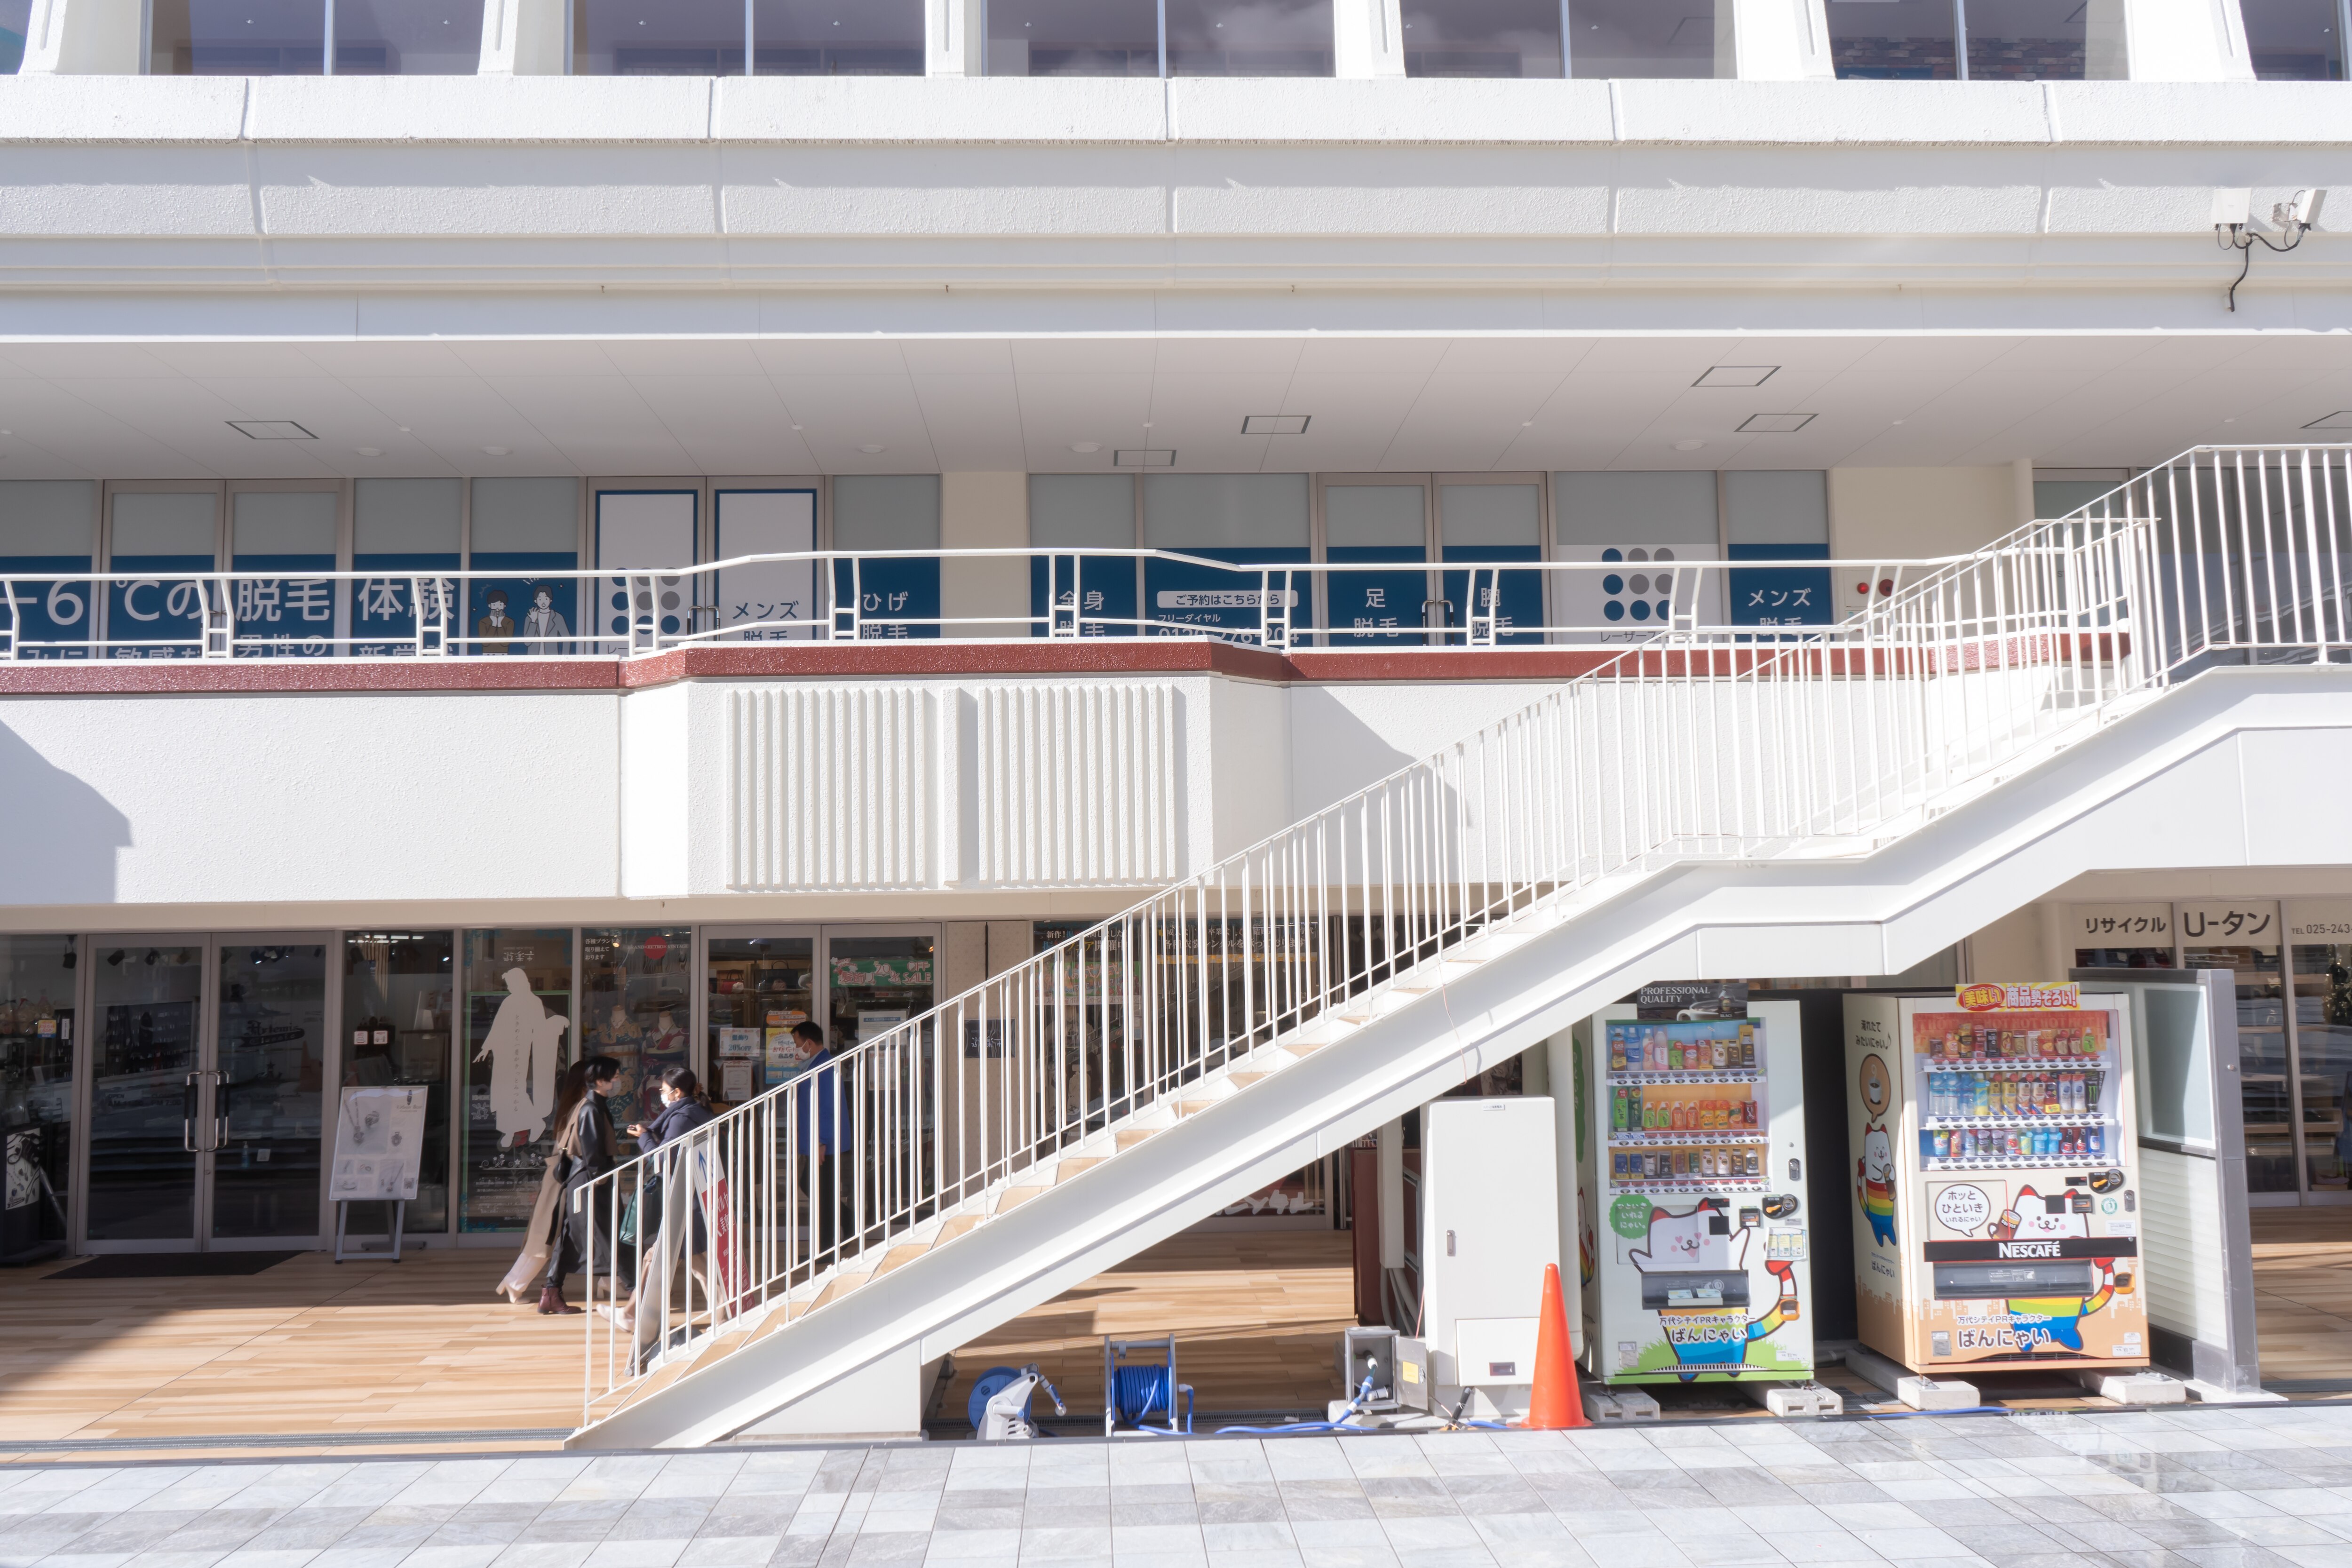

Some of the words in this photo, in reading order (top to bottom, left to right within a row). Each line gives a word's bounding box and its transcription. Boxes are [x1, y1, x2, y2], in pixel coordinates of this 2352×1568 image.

[863, 591, 908, 611] ひげ
[1366, 589, 1385, 608] 足
[1748, 588, 1811, 606] メンズ
[732, 600, 800, 620] メンズ
[1158, 614, 1221, 622] フリーダイヤル
[1353, 618, 1399, 637] 脱毛
[2086, 917, 2166, 933] リサイクル
[2306, 924, 2352, 934] 025-243
[907, 962, 930, 971] OFF
[903, 972, 931, 983] SALE
[1641, 987, 1710, 995] PROFESSIONAL
[1963, 987, 2001, 1008] 美味い
[2006, 985, 2076, 1007] 商品勢ぞろい!
[1640, 995, 1682, 1004] QUALITY
[1947, 1190, 1976, 1201] ホッと
[1942, 1203, 1983, 1213] ひといき
[1998, 1241, 2061, 1258] NESCAFÉ
[1671, 1328, 1746, 1343] ばんにゃい
[1958, 1329, 2050, 1347] ばんにゃい
